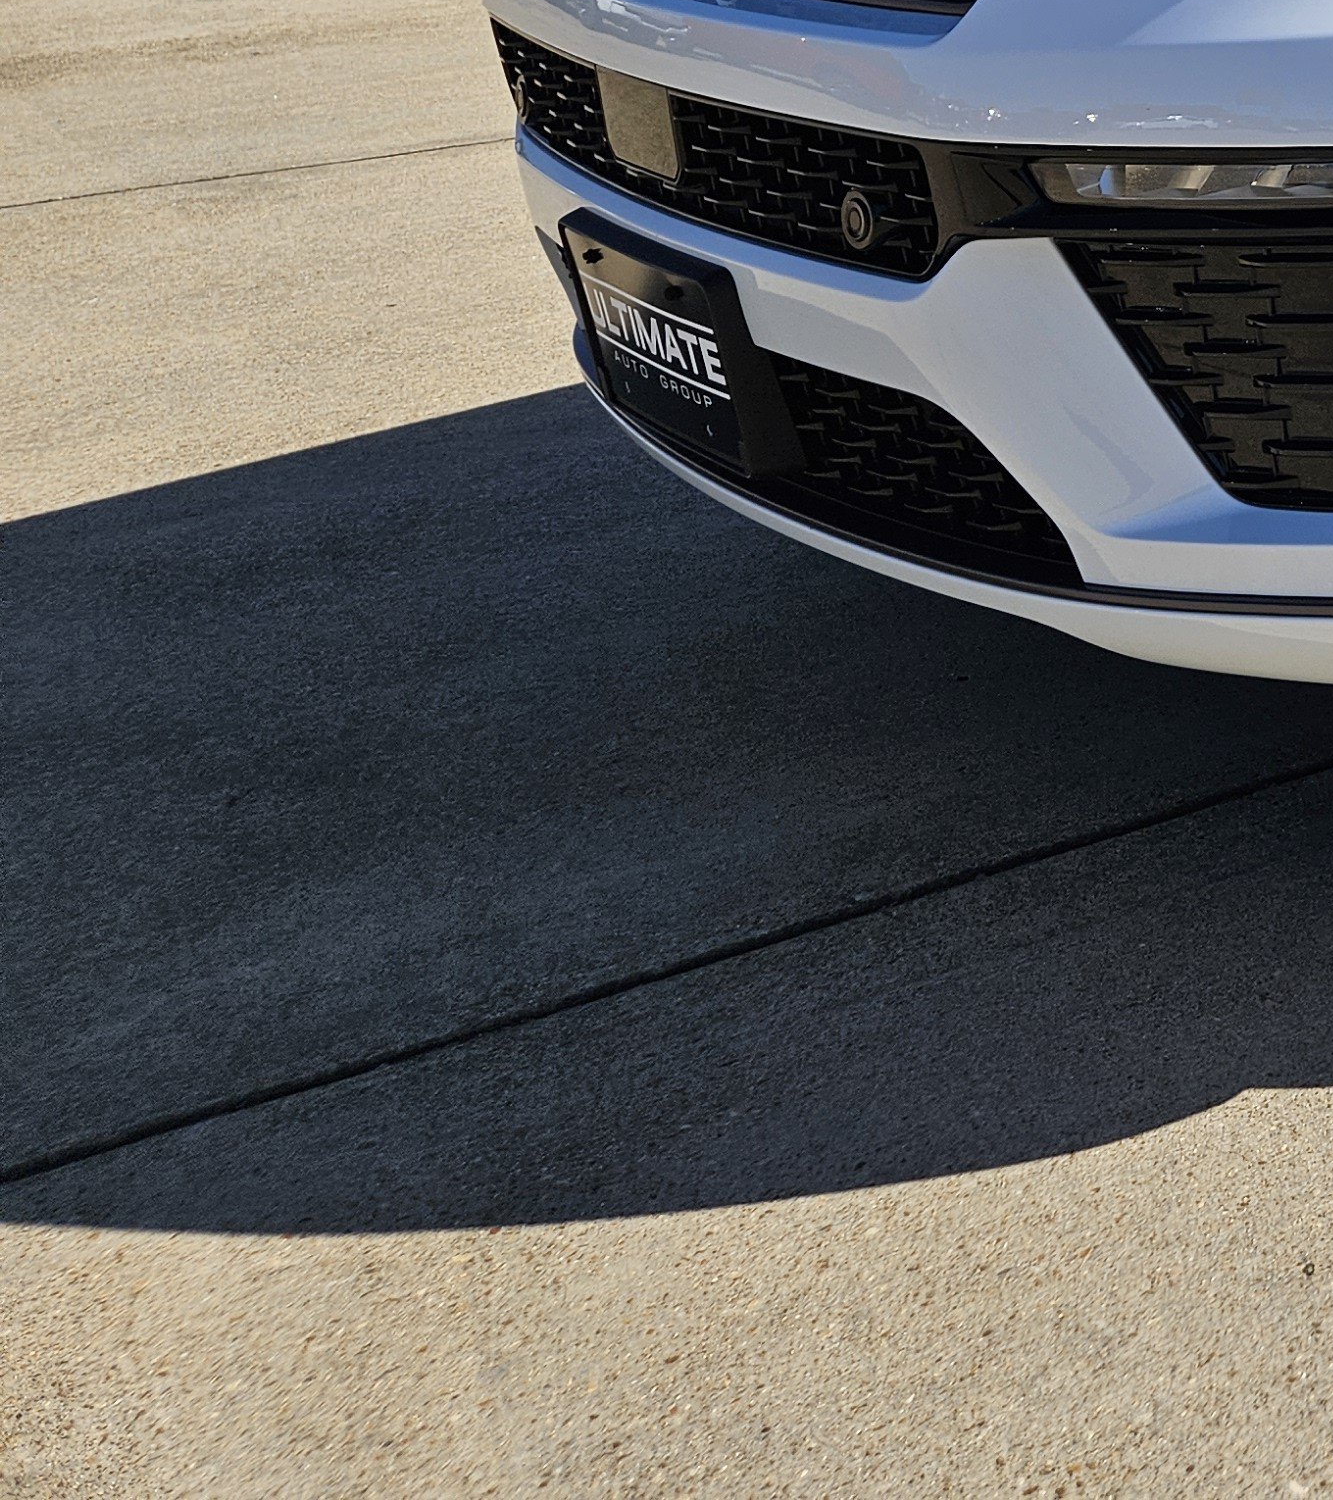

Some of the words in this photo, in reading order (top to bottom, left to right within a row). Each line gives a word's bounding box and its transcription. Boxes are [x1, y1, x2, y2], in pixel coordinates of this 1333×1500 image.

[583, 282, 727, 386] ULTIMATE
[614, 350, 649, 379] AUTO
[659, 374, 713, 408] GROUP
